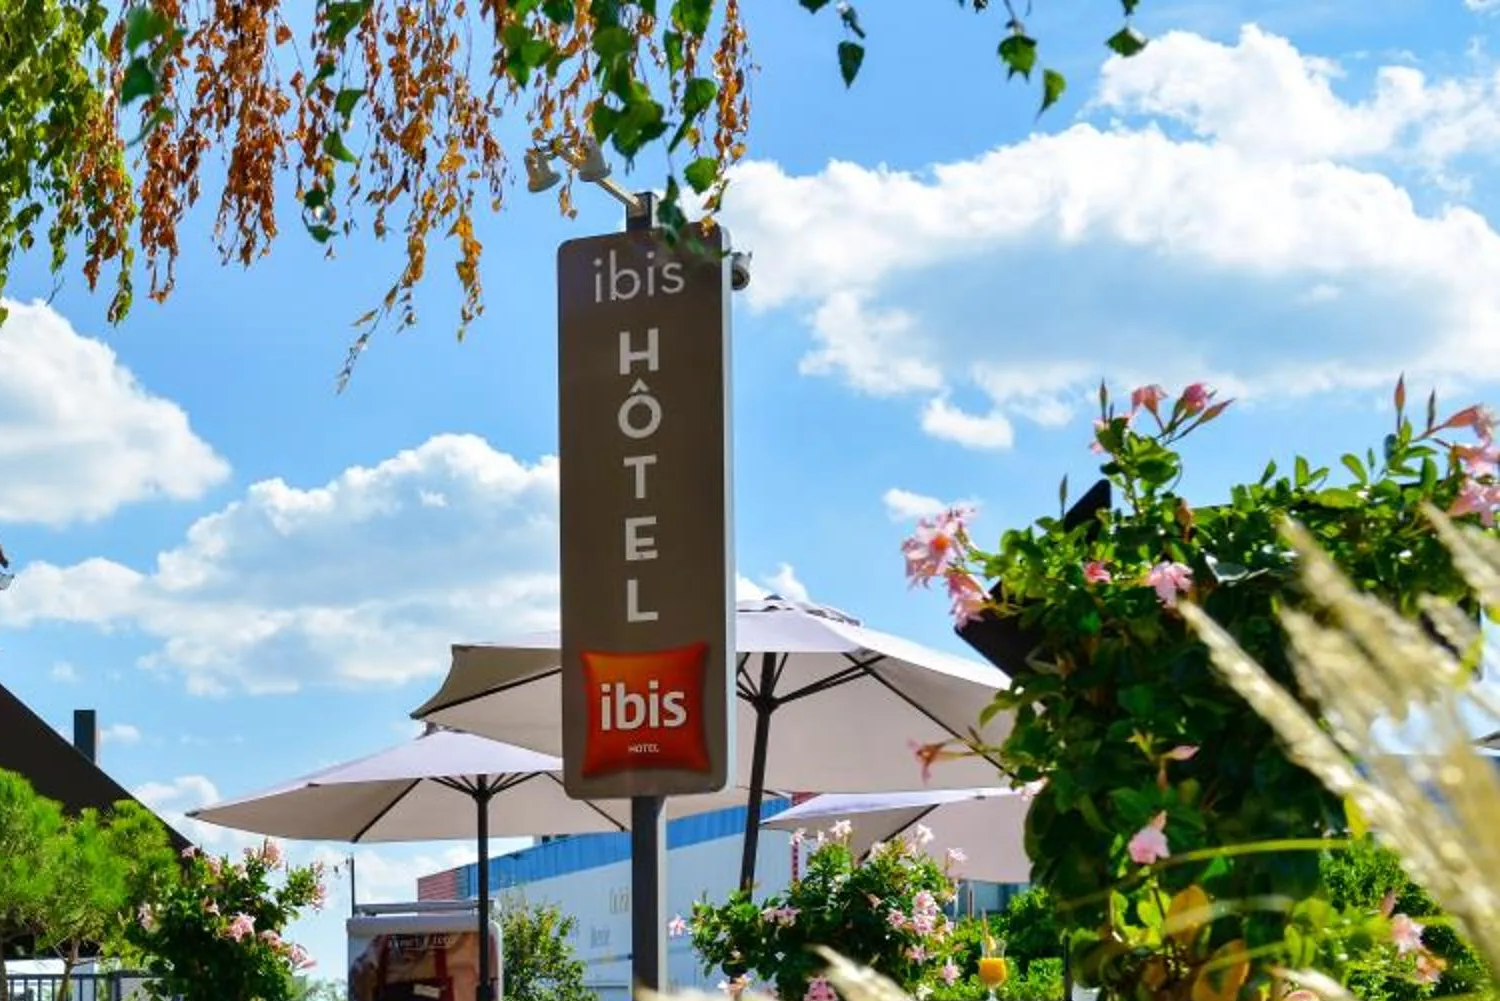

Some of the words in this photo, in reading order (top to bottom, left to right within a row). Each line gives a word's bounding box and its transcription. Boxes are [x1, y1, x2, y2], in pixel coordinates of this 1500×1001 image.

[592, 249, 685, 304] ibis
[617, 327, 663, 623] HÔTEL
[600, 680, 687, 731] ibis
